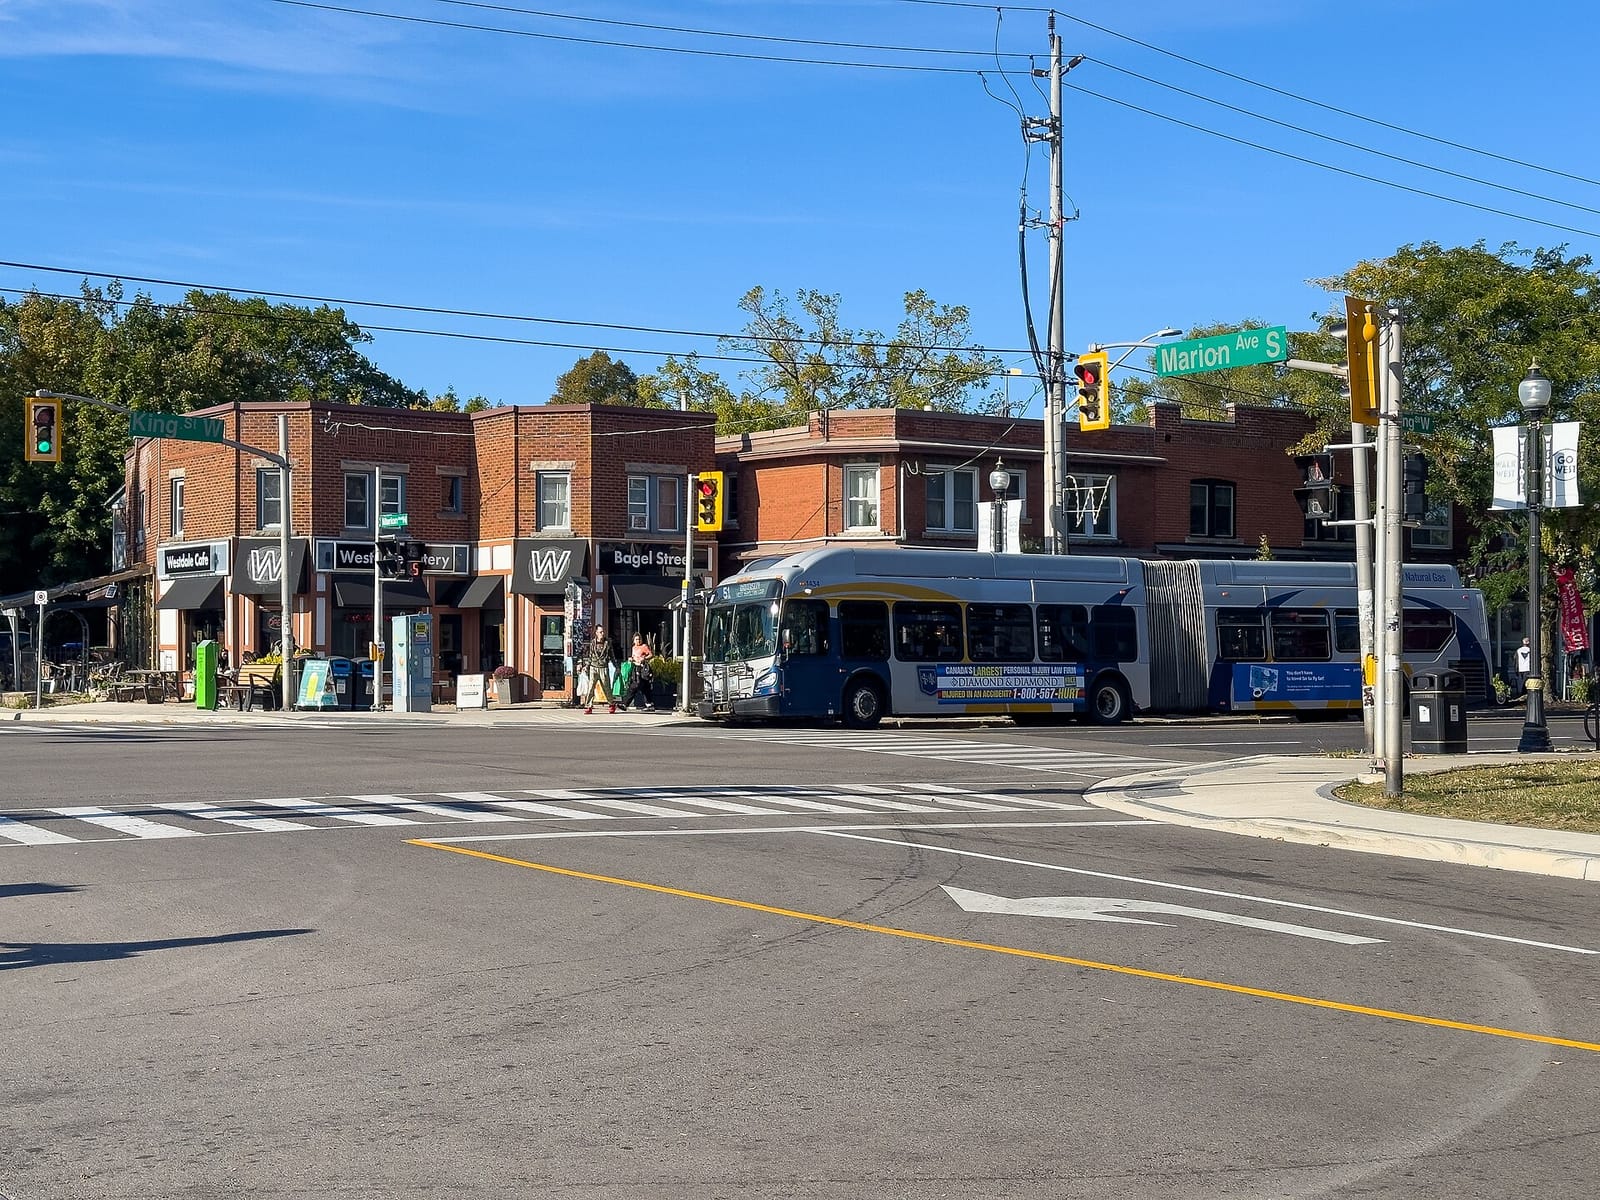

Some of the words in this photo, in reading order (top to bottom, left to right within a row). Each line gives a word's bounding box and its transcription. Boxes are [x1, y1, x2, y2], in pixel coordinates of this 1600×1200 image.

[1161, 343, 1230, 373] Marion
[1235, 335, 1259, 350] Ave
[1266, 331, 1280, 358] S
[131, 412, 178, 438] King
[203, 418, 223, 438] W
[1402, 417, 1414, 431] ng
[1420, 416, 1430, 430] W
[1544, 434, 1552, 499] WESTDALE
[1557, 455, 1573, 465] GO
[1554, 465, 1576, 474] WEST
[166, 552, 194, 569] Westdale
[194, 551, 209, 567] Cafe
[614, 550, 652, 568] Bagel
[656, 551, 693, 566] Stree
[1404, 572, 1431, 581] Natural
[1432, 572, 1447, 582] Gas
[723, 586, 731, 600] 51
[1565, 583, 1577, 613] JUICY
[945, 666, 973, 675] CANADA'S
[973, 666, 1003, 676] LARGEST
[1003, 666, 1031, 674] PERSONAL
[1032, 666, 1050, 675] INJURY
[1063, 666, 1077, 674] FIRM
[958, 677, 1004, 687] DIAMOND
[1005, 678, 1014, 686] &
[1014, 677, 1058, 687] DIAMOND
[942, 690, 966, 698] INJURED
[966, 690, 973, 698] IN
[974, 690, 982, 698] AN
[983, 690, 1012, 698] ACCIDENT?
[1013, 687, 1079, 700] 1-800-567-HURT
